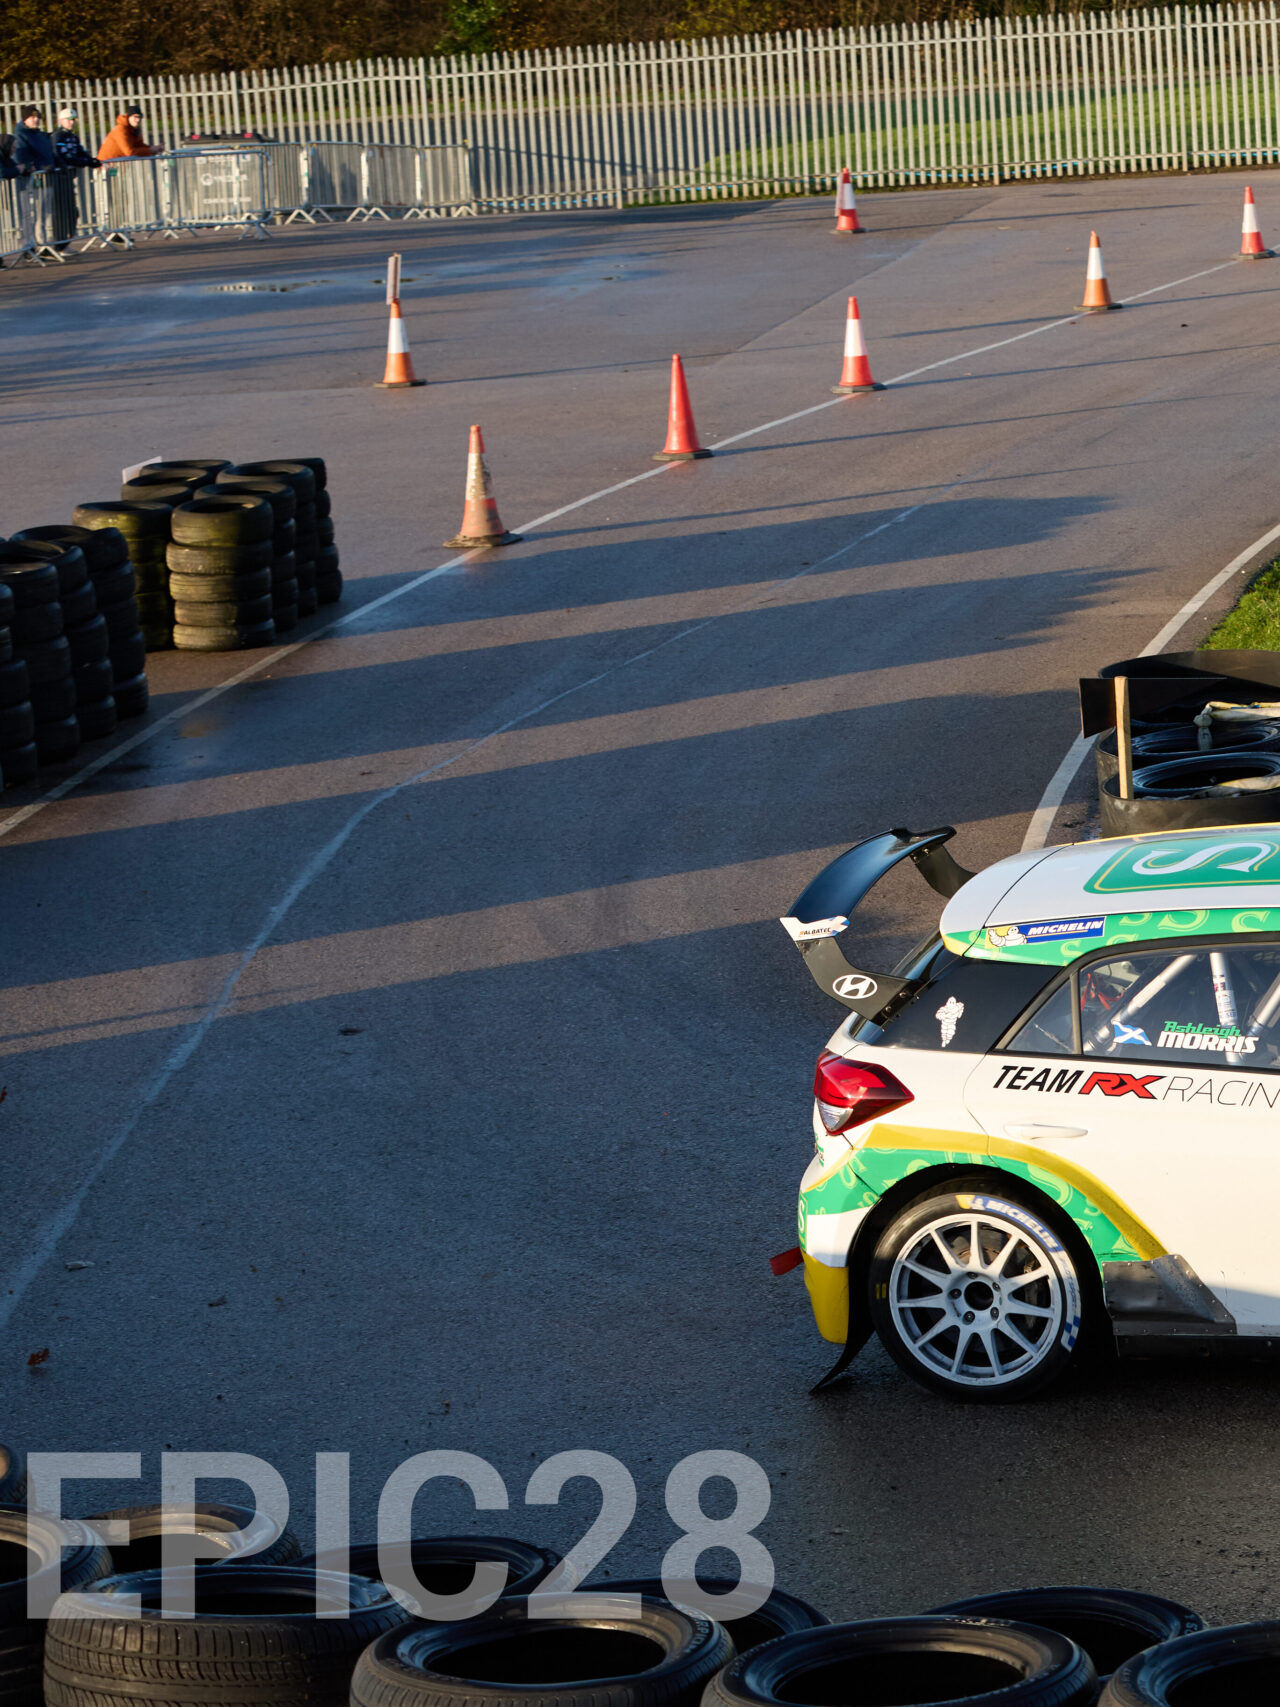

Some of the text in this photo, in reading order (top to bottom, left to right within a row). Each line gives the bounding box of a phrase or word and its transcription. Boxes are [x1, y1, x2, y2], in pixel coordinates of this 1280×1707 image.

[1028, 919, 1104, 936] MICHELIN
[1164, 1021, 1242, 1039] Ashleigh
[1157, 1031, 1260, 1054] MORRIS
[993, 1065, 1085, 1095] TEAM
[1077, 1070, 1168, 1100] RX
[985, 1200, 1059, 1249] MICHELIN
